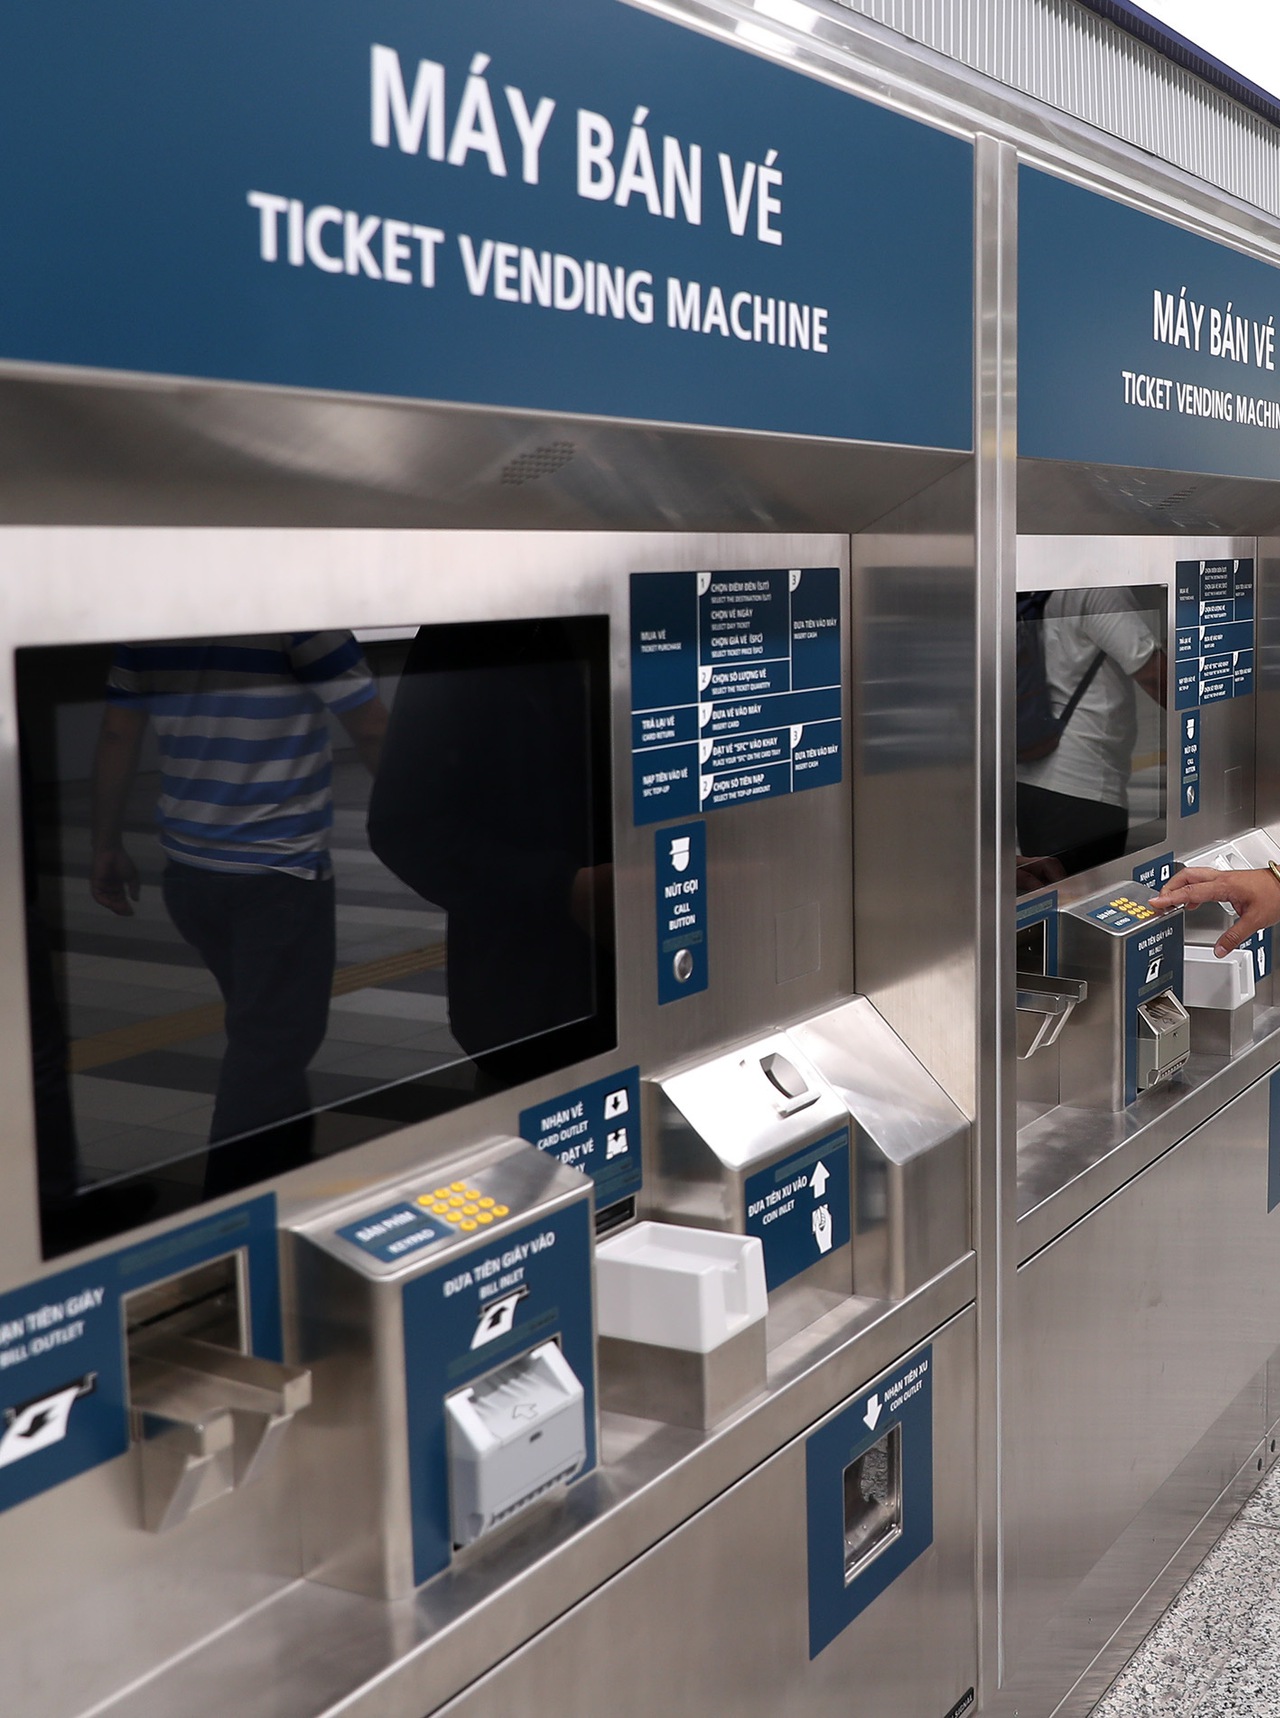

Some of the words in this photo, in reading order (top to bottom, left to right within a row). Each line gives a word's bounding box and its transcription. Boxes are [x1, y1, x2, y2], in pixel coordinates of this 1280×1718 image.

[370, 42, 556, 185] MÁY
[576, 105, 701, 226] BÁN
[718, 148, 783, 246] VÉ
[246, 189, 444, 288] TICKET
[458, 233, 654, 325] VENDING
[666, 276, 829, 353] MACHINE
[1153, 285, 1205, 352] MÁY
[1210, 302, 1249, 364] BÁN
[1253, 315, 1275, 371] VÉ
[1121, 370, 1173, 411] TICKET
[1176, 382, 1233, 422] VENDING
[664, 882, 682, 898] NÚT
[683, 879, 699, 895] GỌI
[668, 914, 696, 931] BUTTON
[673, 902, 691, 915] CALL
[571, 1100, 584, 1119] VÉ
[537, 1133, 560, 1150] CARD
[560, 1120, 588, 1141] OUTLET
[582, 1137, 594, 1155] VÉ
[748, 1199, 765, 1217] ĐƯA
[782, 1183, 792, 1199] XU
[792, 1175, 807, 1192] VÀO
[762, 1209, 778, 1225] COIN
[779, 1199, 795, 1216] INLET
[387, 1228, 436, 1254] KEYPAD
[530, 1231, 556, 1254] VÀO
[479, 1282, 498, 1300] BILL
[499, 1267, 525, 1289] INLET
[30, 1320, 85, 1356] OUTLET
[919, 1360, 928, 1375] XU
[890, 1395, 903, 1412] COIN
[903, 1379, 923, 1401] OUTLET
